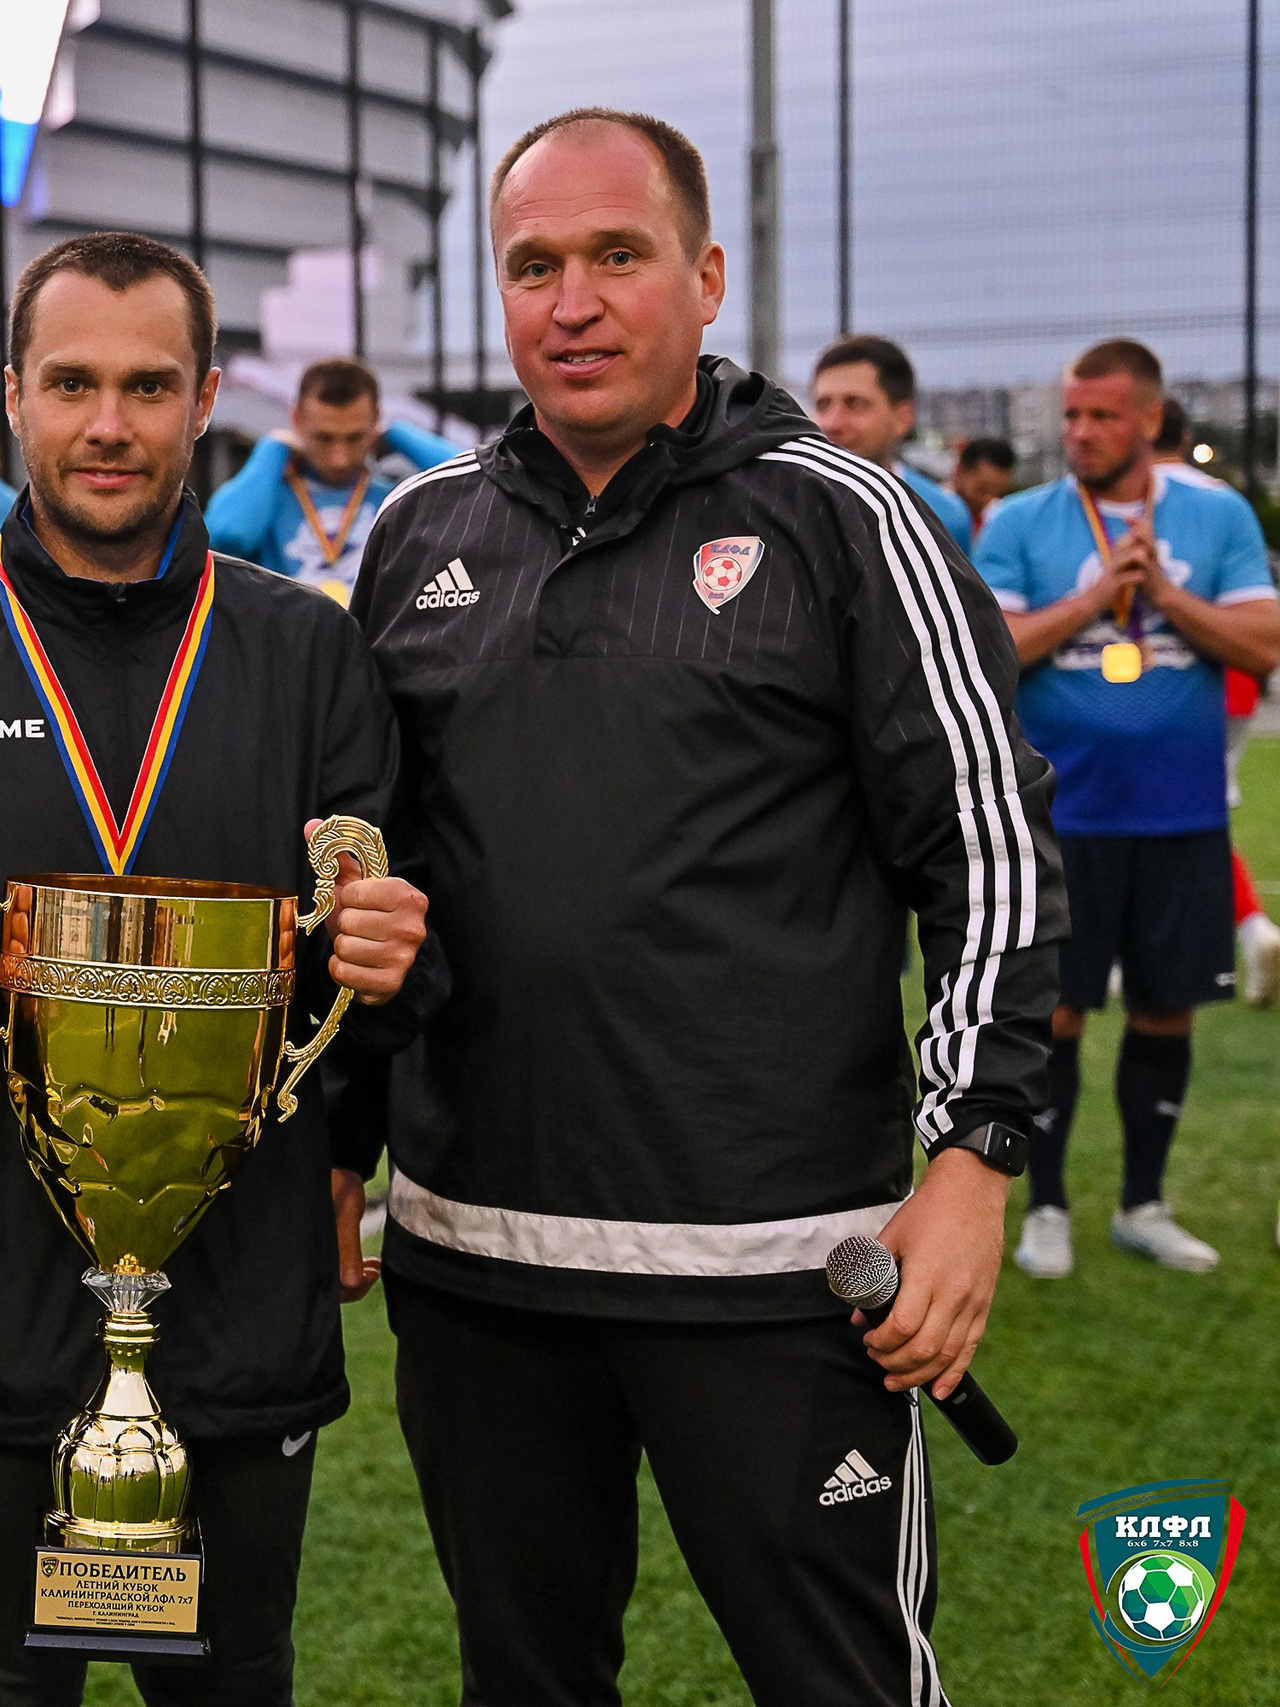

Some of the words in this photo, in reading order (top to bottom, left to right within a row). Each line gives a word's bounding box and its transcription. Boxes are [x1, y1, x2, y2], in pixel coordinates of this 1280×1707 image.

[415, 588, 481, 610] adidas
[819, 1476, 892, 1506] adidas
[59, 1562, 187, 1582] ПОБЕДИТЕЛЬ
[76, 1580, 120, 1591] ЛЕТНИЙ
[122, 1582, 159, 1593] КУБОК
[40, 1588, 150, 1603] КАЛИНИНГРАДСКОЙ
[153, 1593, 175, 1605] ЛФЛ
[67, 1600, 133, 1611] ПЕРЕХОДЯЩИЙ
[135, 1604, 165, 1613] КУБОК
